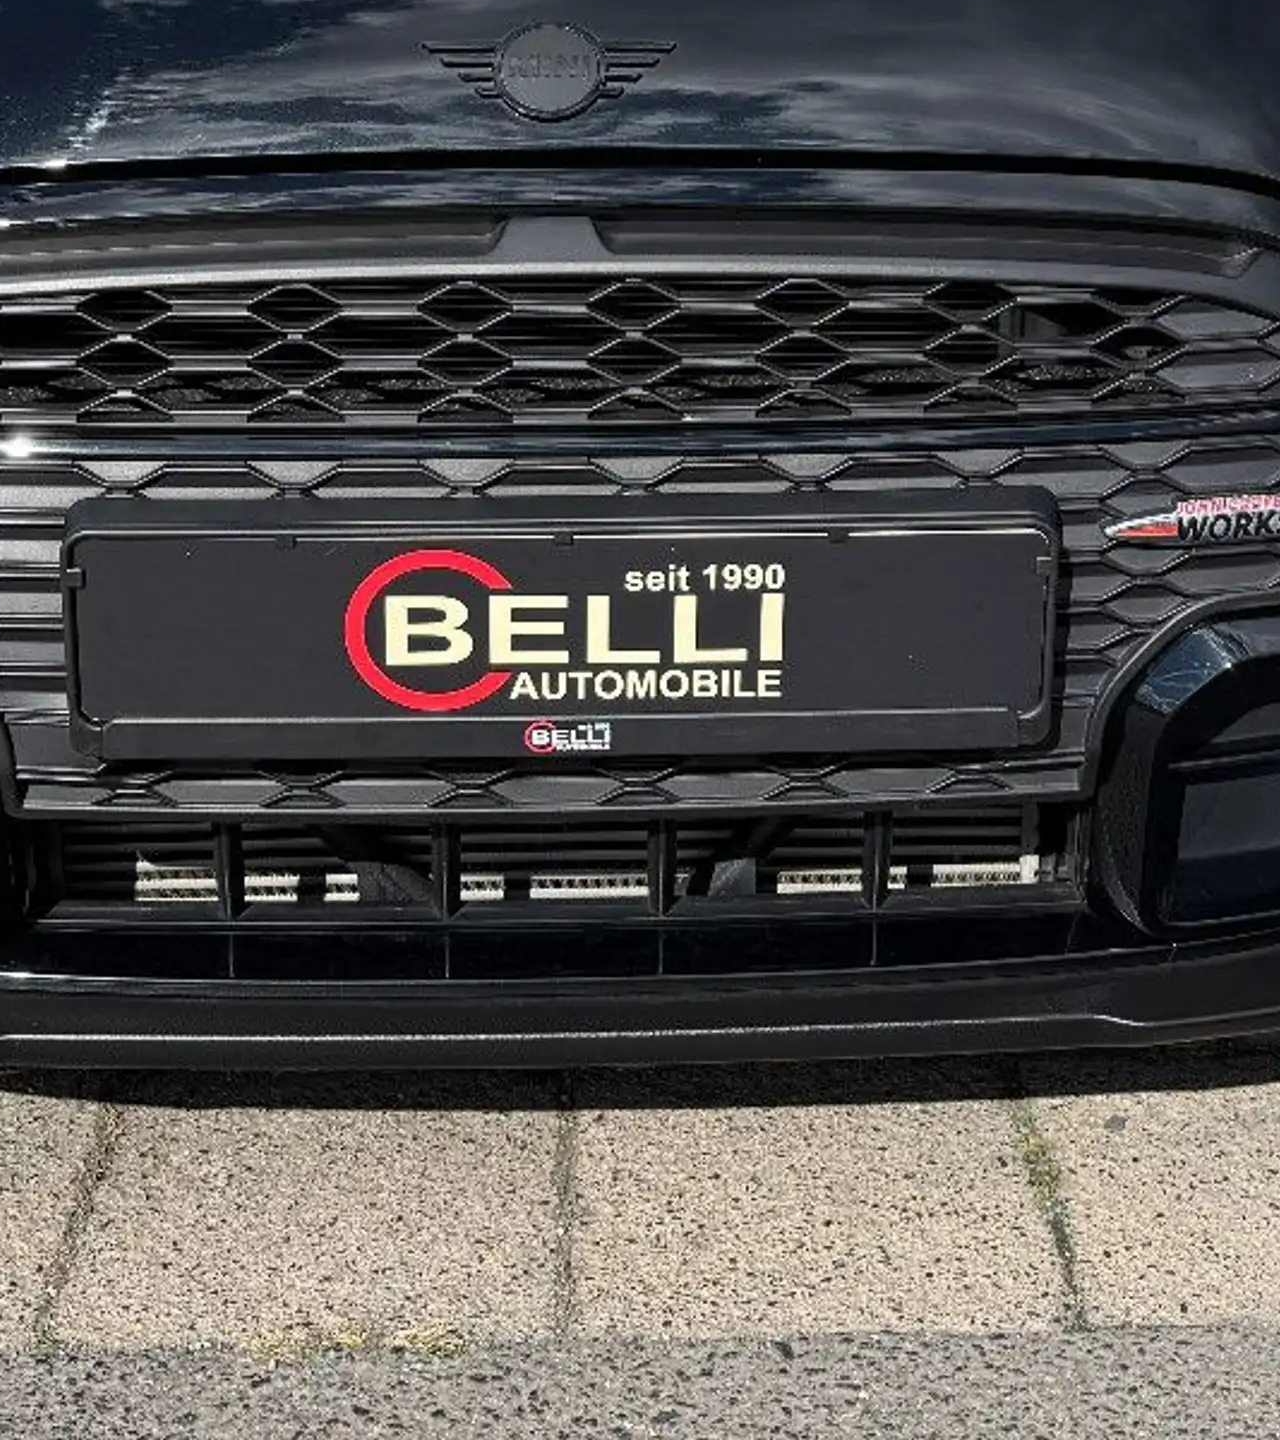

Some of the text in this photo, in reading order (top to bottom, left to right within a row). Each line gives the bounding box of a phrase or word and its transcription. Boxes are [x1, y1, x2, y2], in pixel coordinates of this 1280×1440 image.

[624, 563, 787, 592] seit 1990
[384, 592, 786, 667] BELLI
[510, 669, 783, 701] AUTOMOBILE
[531, 727, 611, 746] BELLI
